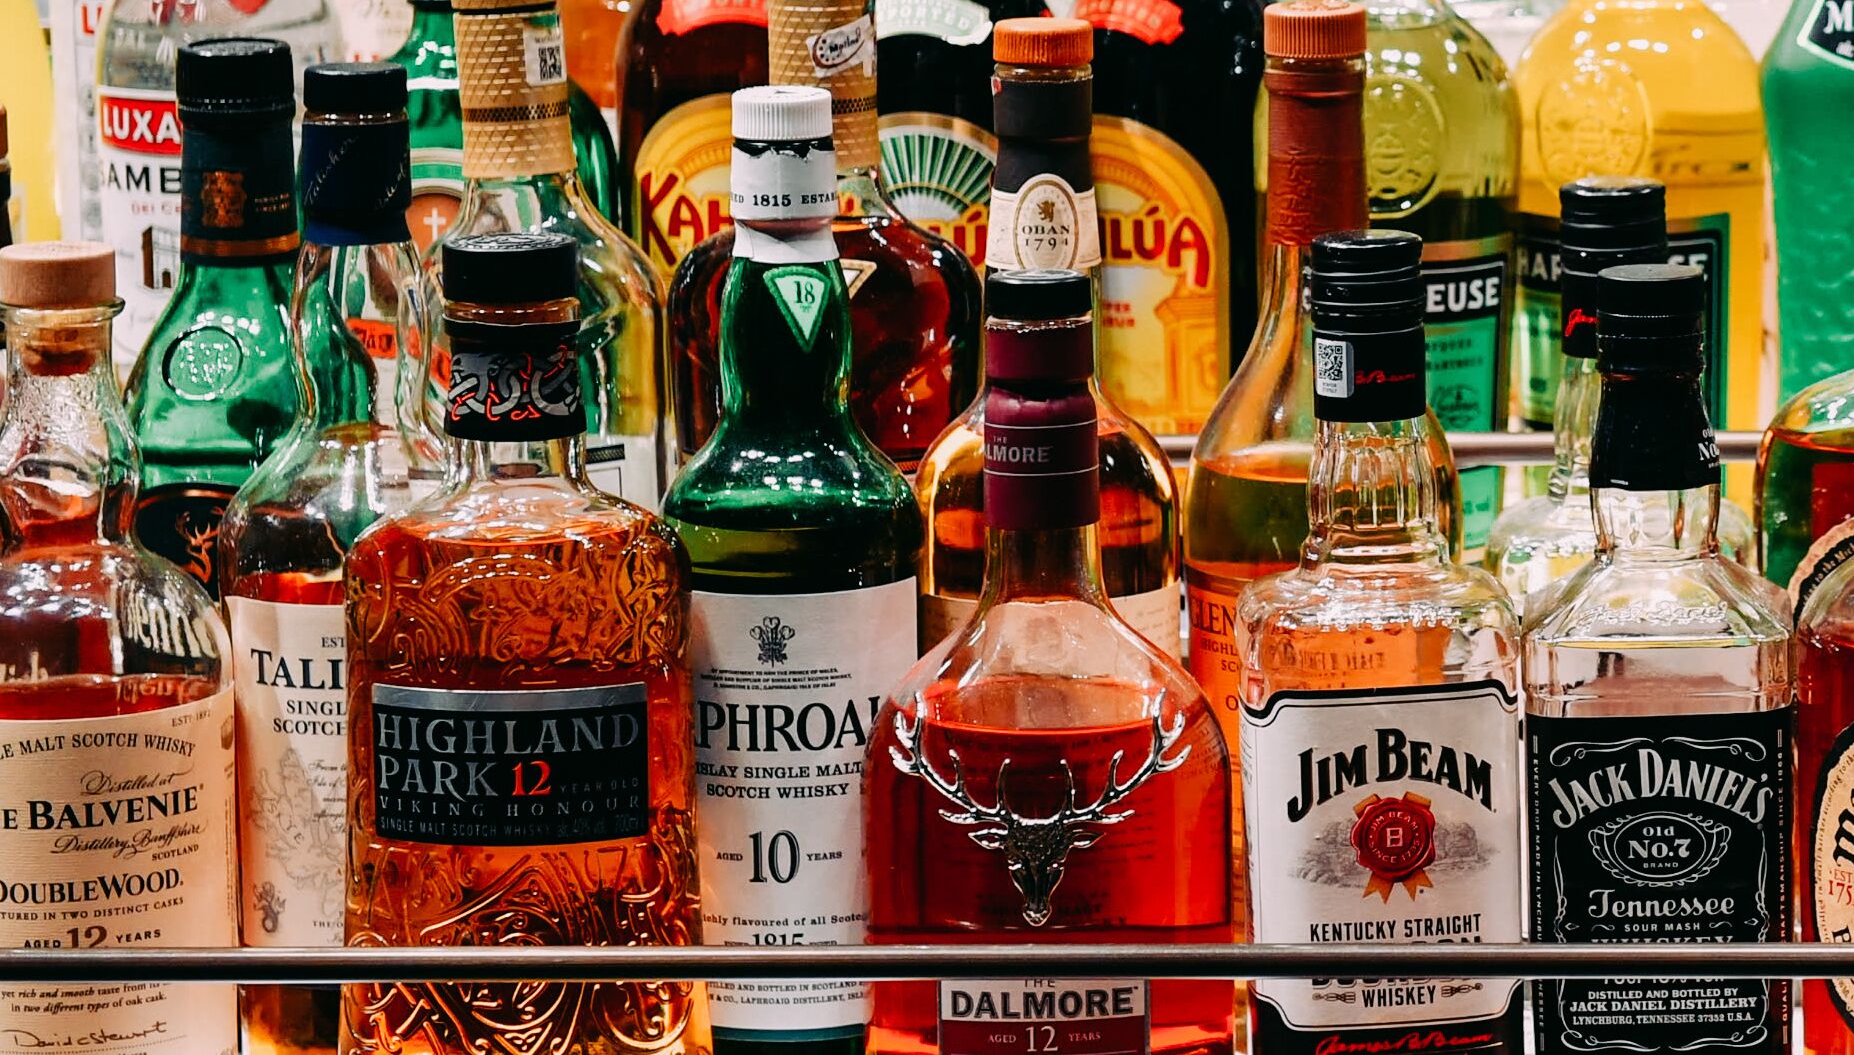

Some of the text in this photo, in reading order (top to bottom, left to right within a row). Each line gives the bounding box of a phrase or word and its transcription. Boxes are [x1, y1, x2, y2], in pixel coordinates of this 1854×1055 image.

[103, 106, 180, 146] LUXA
[753, 194, 792, 207] 1815
[1021, 223, 1071, 236] OBAN
[1100, 205, 1211, 289] LÚA
[792, 280, 816, 305] 18
[1425, 276, 1500, 314] EUSE
[984, 444, 1053, 464] LMORE
[250, 649, 345, 690] TALI
[377, 712, 640, 754] HIGHLAND
[695, 696, 880, 752] PHROA
[19, 732, 197, 758] MALT SCOTCH WHISKY
[378, 754, 640, 803] PARK 12 YEAR OLD
[743, 760, 862, 779] SINGLE MALT
[1286, 727, 1495, 824] JIM BEAM
[706, 782, 850, 800] SCOTCH WHISKY
[1547, 747, 1775, 830] JACK DANIEL'S
[27, 785, 199, 831] BALVENIE
[379, 795, 640, 817] VIKING HONOUR
[380, 817, 497, 837] SINGLE MALT SCOTCH
[1385, 827, 1403, 848] B
[1642, 825, 1675, 838] Old
[151, 844, 200, 862] SCOTLAND
[715, 829, 843, 884] AGED 10 YEARS
[1642, 861, 1679, 869] BRAND
[61, 896, 185, 920] TWO DISTINCT CASKS
[1588, 888, 1735, 919] Tennessee
[732, 914, 826, 927] flavoured all
[1309, 913, 1482, 943] KENTUCKY STRAIGHT
[1623, 921, 1701, 933] SOUR MASH
[66, 924, 163, 949] 12 YEARS
[811, 980, 857, 991] SCOTLAND
[1361, 984, 1437, 1009] WHISKEY
[1588, 987, 1739, 1000] DISTILLED AND BOTTLED BY
[43, 1000, 85, 1015] different
[950, 987, 1135, 1019] DALMORE
[1569, 996, 1758, 1013] JACK DANIEL DISTILLERY
[1572, 1014, 1636, 1027] LYNCHBURG,
[1636, 1013, 1696, 1025] TENNESSEE
[1726, 1011, 1755, 1022] U.S.A.
[987, 1025, 1101, 1053] AGED 12 YEARS
